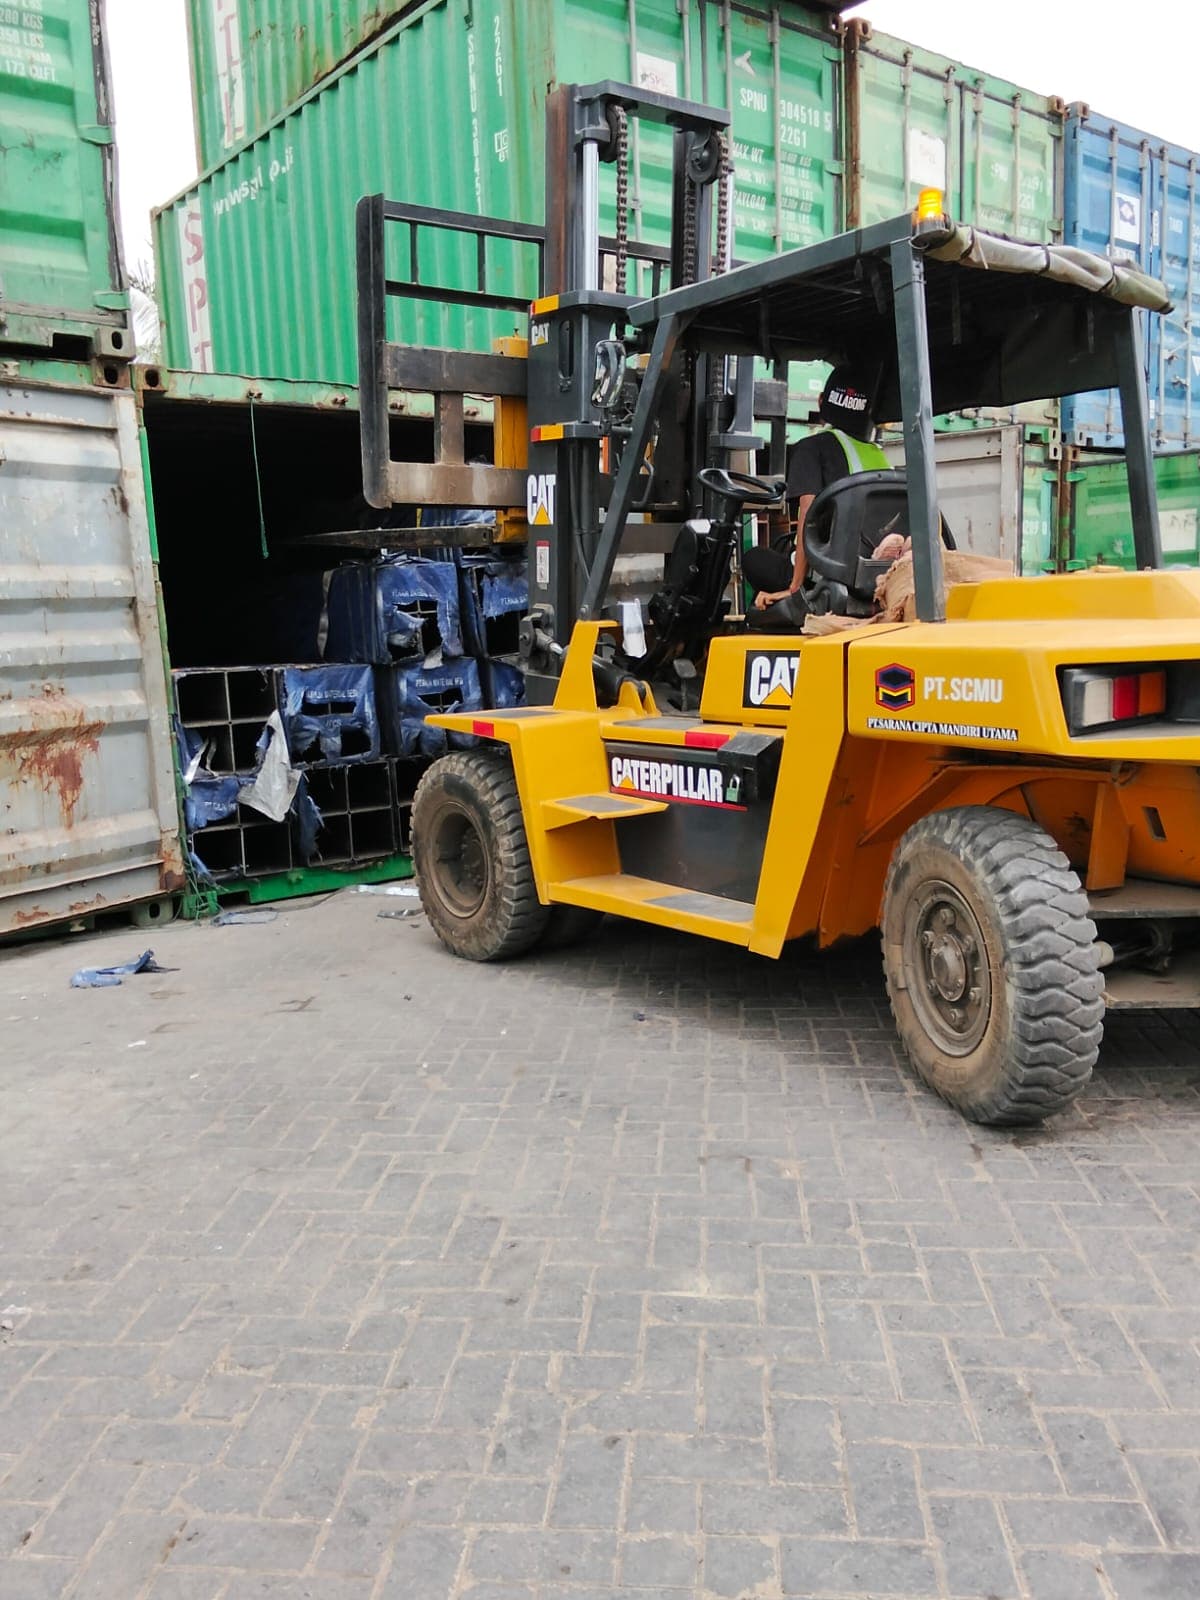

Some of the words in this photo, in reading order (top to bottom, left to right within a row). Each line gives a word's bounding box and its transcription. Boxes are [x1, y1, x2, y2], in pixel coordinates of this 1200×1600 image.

[22, 12, 44, 30] KGS
[494, 15, 502, 97] 22G1
[740, 87, 767, 112] SPNU
[780, 99, 819, 128] 304518
[780, 124, 807, 149] 22G1
[531, 322, 550, 346] CAT
[527, 474, 557, 526] CAT
[923, 676, 1003, 704] PT.SCMU
[912, 721, 938, 735] CIPTA
[939, 723, 981, 738] MANDIRI
[982, 727, 1018, 741] UTAMA
[611, 757, 723, 803] CATERPILLAR
